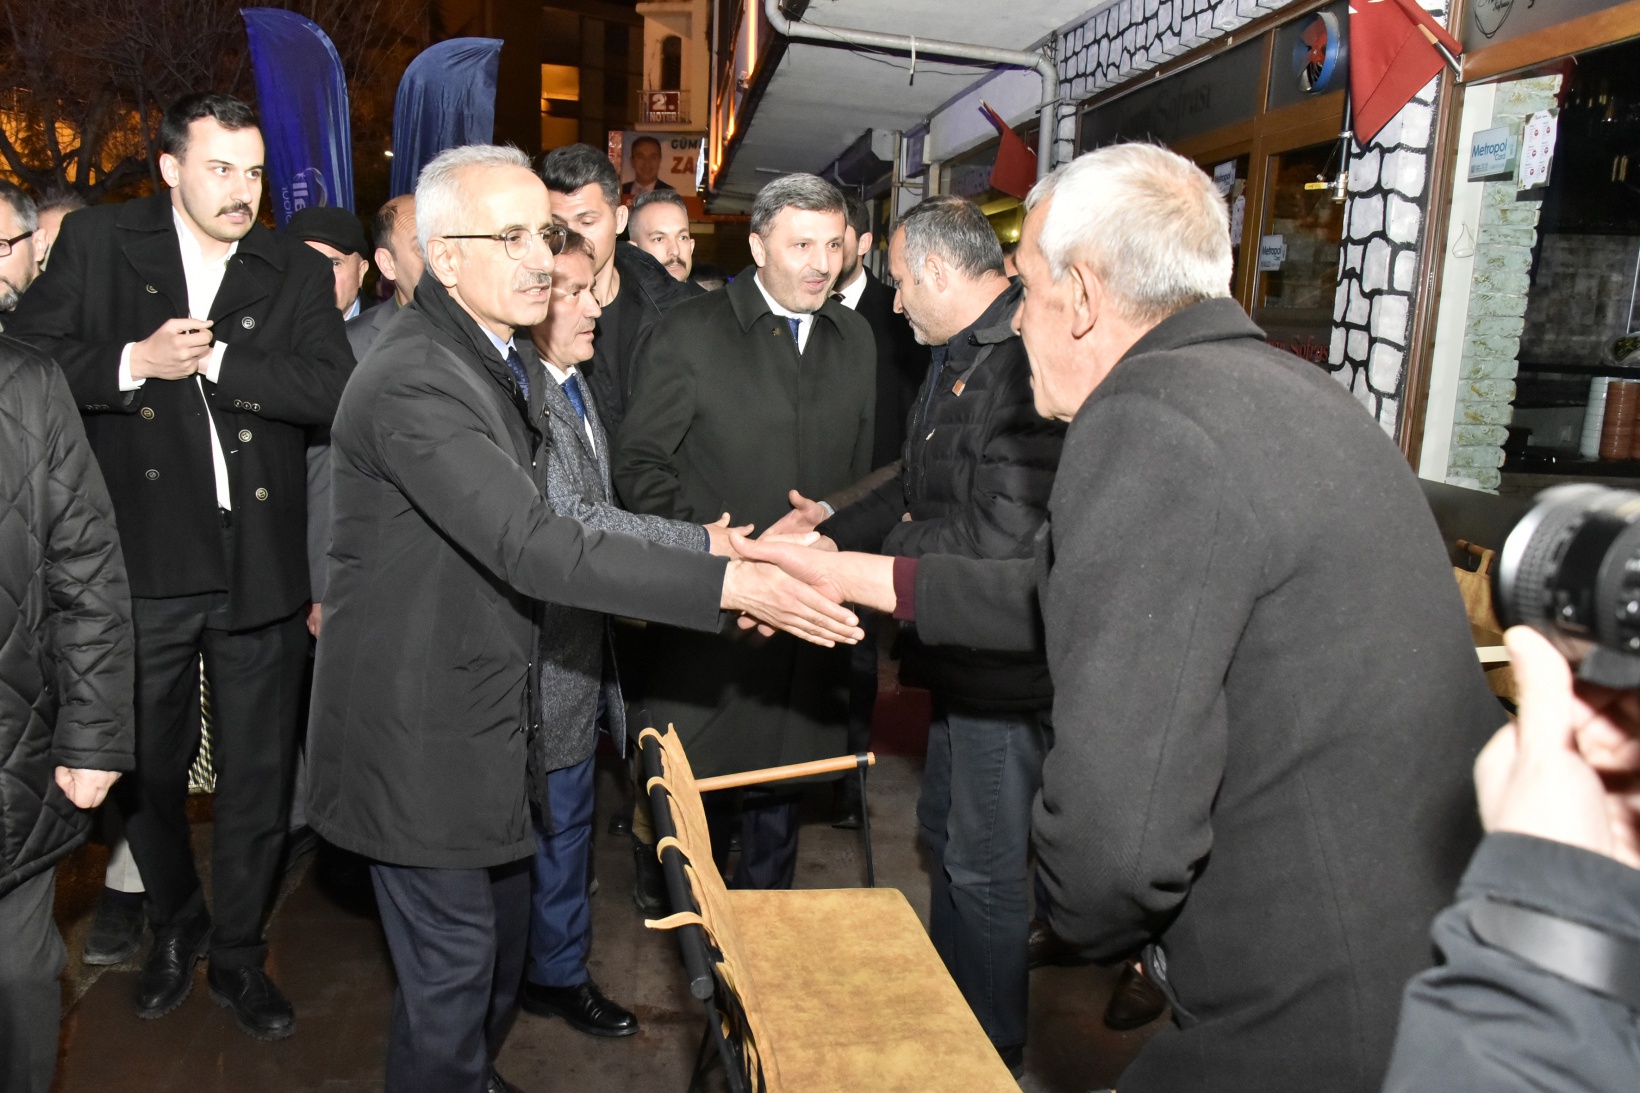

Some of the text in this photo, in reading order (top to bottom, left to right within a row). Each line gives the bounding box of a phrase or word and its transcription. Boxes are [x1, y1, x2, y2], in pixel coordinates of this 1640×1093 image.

[652, 93, 675, 110] 2.
[649, 111, 677, 122] NOTER
[671, 136, 702, 149] GÜM
[1472, 138, 1508, 157] Metropol
